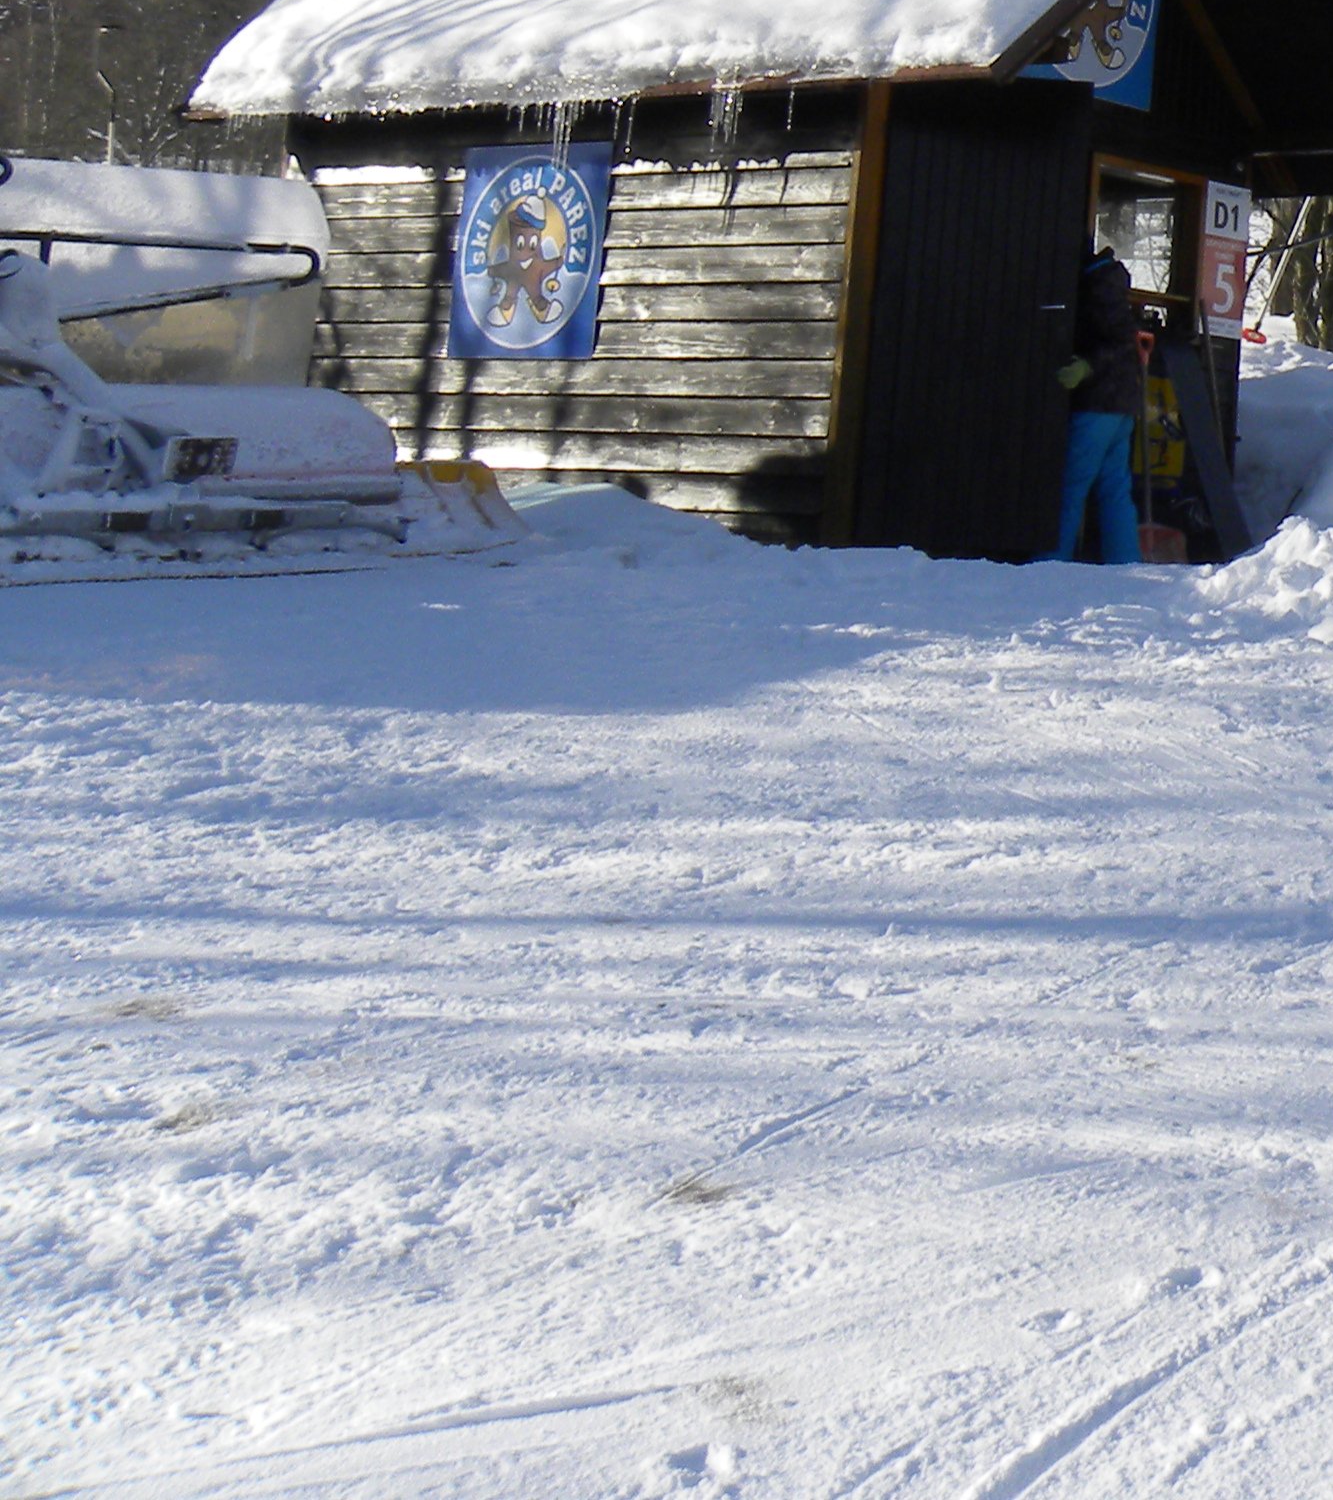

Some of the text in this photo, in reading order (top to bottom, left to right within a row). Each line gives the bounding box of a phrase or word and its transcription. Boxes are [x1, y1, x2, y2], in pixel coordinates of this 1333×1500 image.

[471, 168, 589, 266] ski areal PAŘEZ
[1214, 200, 1239, 232] D1
[1212, 263, 1235, 314] 5
